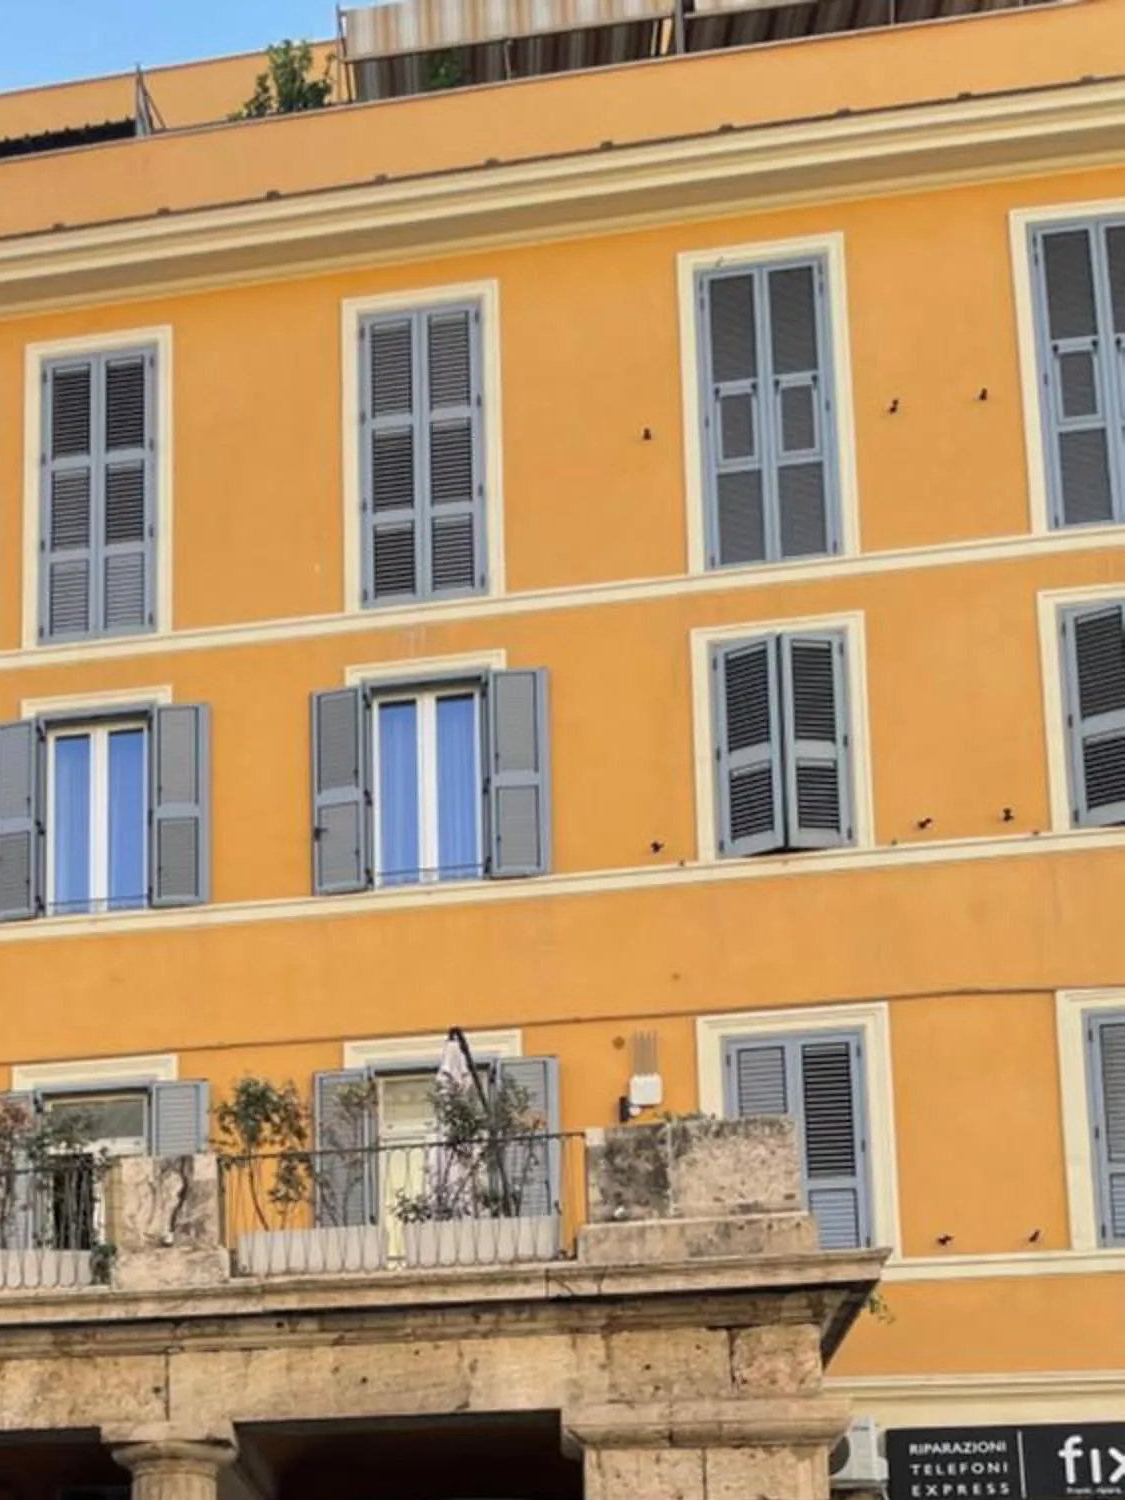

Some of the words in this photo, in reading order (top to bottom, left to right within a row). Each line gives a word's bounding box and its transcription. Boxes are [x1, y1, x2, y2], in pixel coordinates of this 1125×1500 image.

[909, 1440, 1007, 1455] RIPARAZIONI
[909, 1461, 1009, 1475] TELEFONI
[911, 1482, 1010, 1497] EXPRESS
